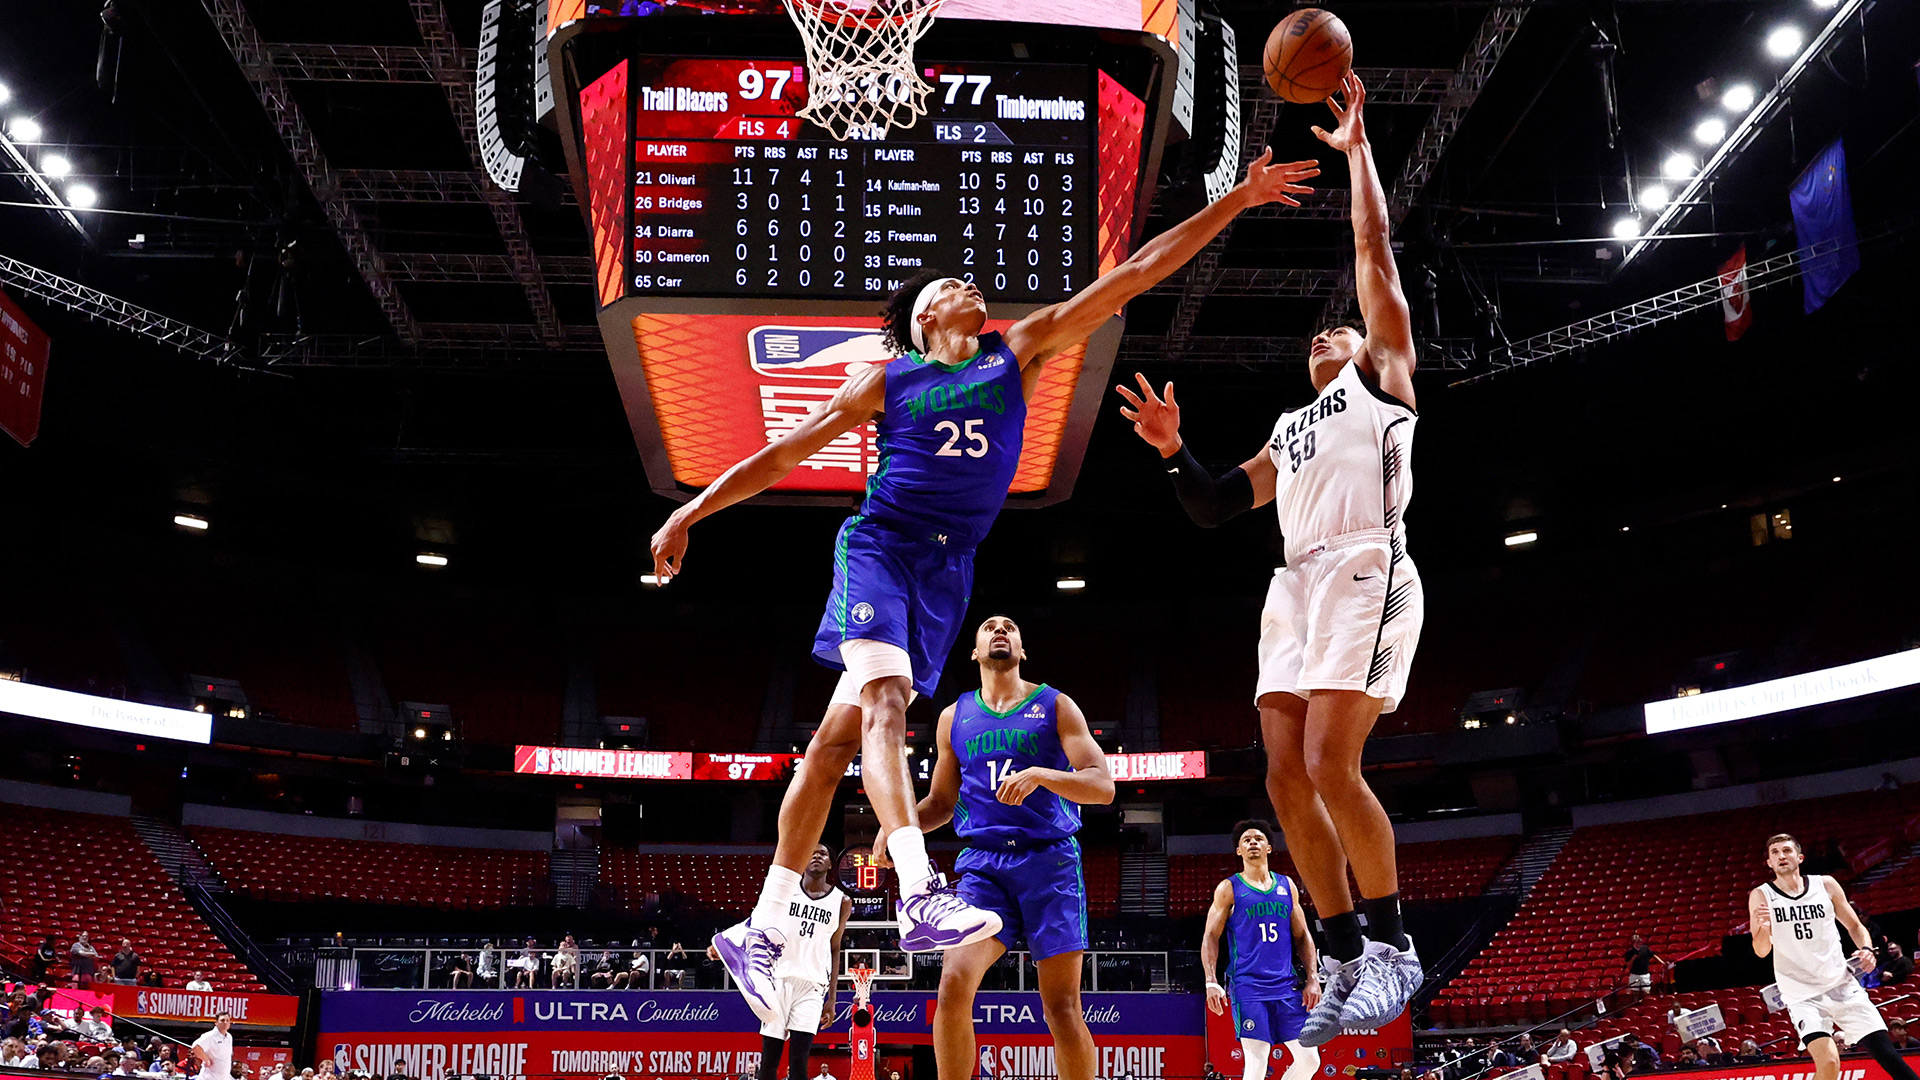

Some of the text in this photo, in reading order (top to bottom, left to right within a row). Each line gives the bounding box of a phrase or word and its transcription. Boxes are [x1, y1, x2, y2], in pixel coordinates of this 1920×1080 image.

[738, 69, 791, 100] 97
[939, 74, 991, 105] 77
[642, 86, 728, 112] Trail Blazers
[996, 94, 1085, 120] Timberwolves
[739, 121, 789, 138] FLS 4
[936, 125, 986, 143] FLS 2
[647, 144, 848, 160] PLAYER PTS RBS AST FLS
[874, 149, 1074, 165] PLAYER PTS RBS AST FLS
[636, 168, 845, 187] 21 Olivari 11 7 4 1
[866, 173, 1073, 192] 14 Kaufman-Renn 10 5 0 3
[635, 193, 845, 212] 26 Bridges 3 0 1 1
[865, 197, 1072, 217] 15 Pullin 13 4 10 2
[635, 219, 845, 238] 34 Diarra 6 6 0 2
[864, 223, 1073, 243] 25 Freeman 4 7 4 3
[635, 243, 845, 263] 50 Cameron 0 1 0 0
[864, 248, 1073, 268] 33 Evans 2 1 0 3
[635, 268, 845, 288] 65 Carr 6 2 0 2
[865, 278, 881, 291] 50
[995, 273, 1006, 290] 0
[1028, 274, 1039, 291] 0
[1063, 274, 1072, 291] 1
[764, 334, 800, 360] NBA
[906, 381, 1006, 423] WOLVES
[934, 419, 989, 458] 25
[1288, 430, 1316, 473] 50
[965, 728, 1039, 760] WOLVES
[550, 750, 671, 777] SUMMER LEAGUE
[709, 754, 772, 763] Trail Blazers
[919, 759, 929, 772] 1
[1131, 755, 1185, 777] LEAGUE
[728, 763, 756, 780] 97
[857, 866, 877, 889] 18
[789, 901, 832, 925] BLAZERS
[1245, 901, 1288, 920] WOLVES
[1773, 904, 1826, 923] BLAZERS
[799, 920, 815, 939] 34
[1259, 922, 1279, 943] 15
[1794, 922, 1813, 940] 65
[149, 993, 249, 1020] SUMMER LEAGUE
[409, 999, 720, 1023] Michelob ULTRA Courtside
[355, 1043, 528, 1080] SUMMER LEAGUE
[551, 1050, 762, 1074] TOMORROW'S STARS PLAY HER
